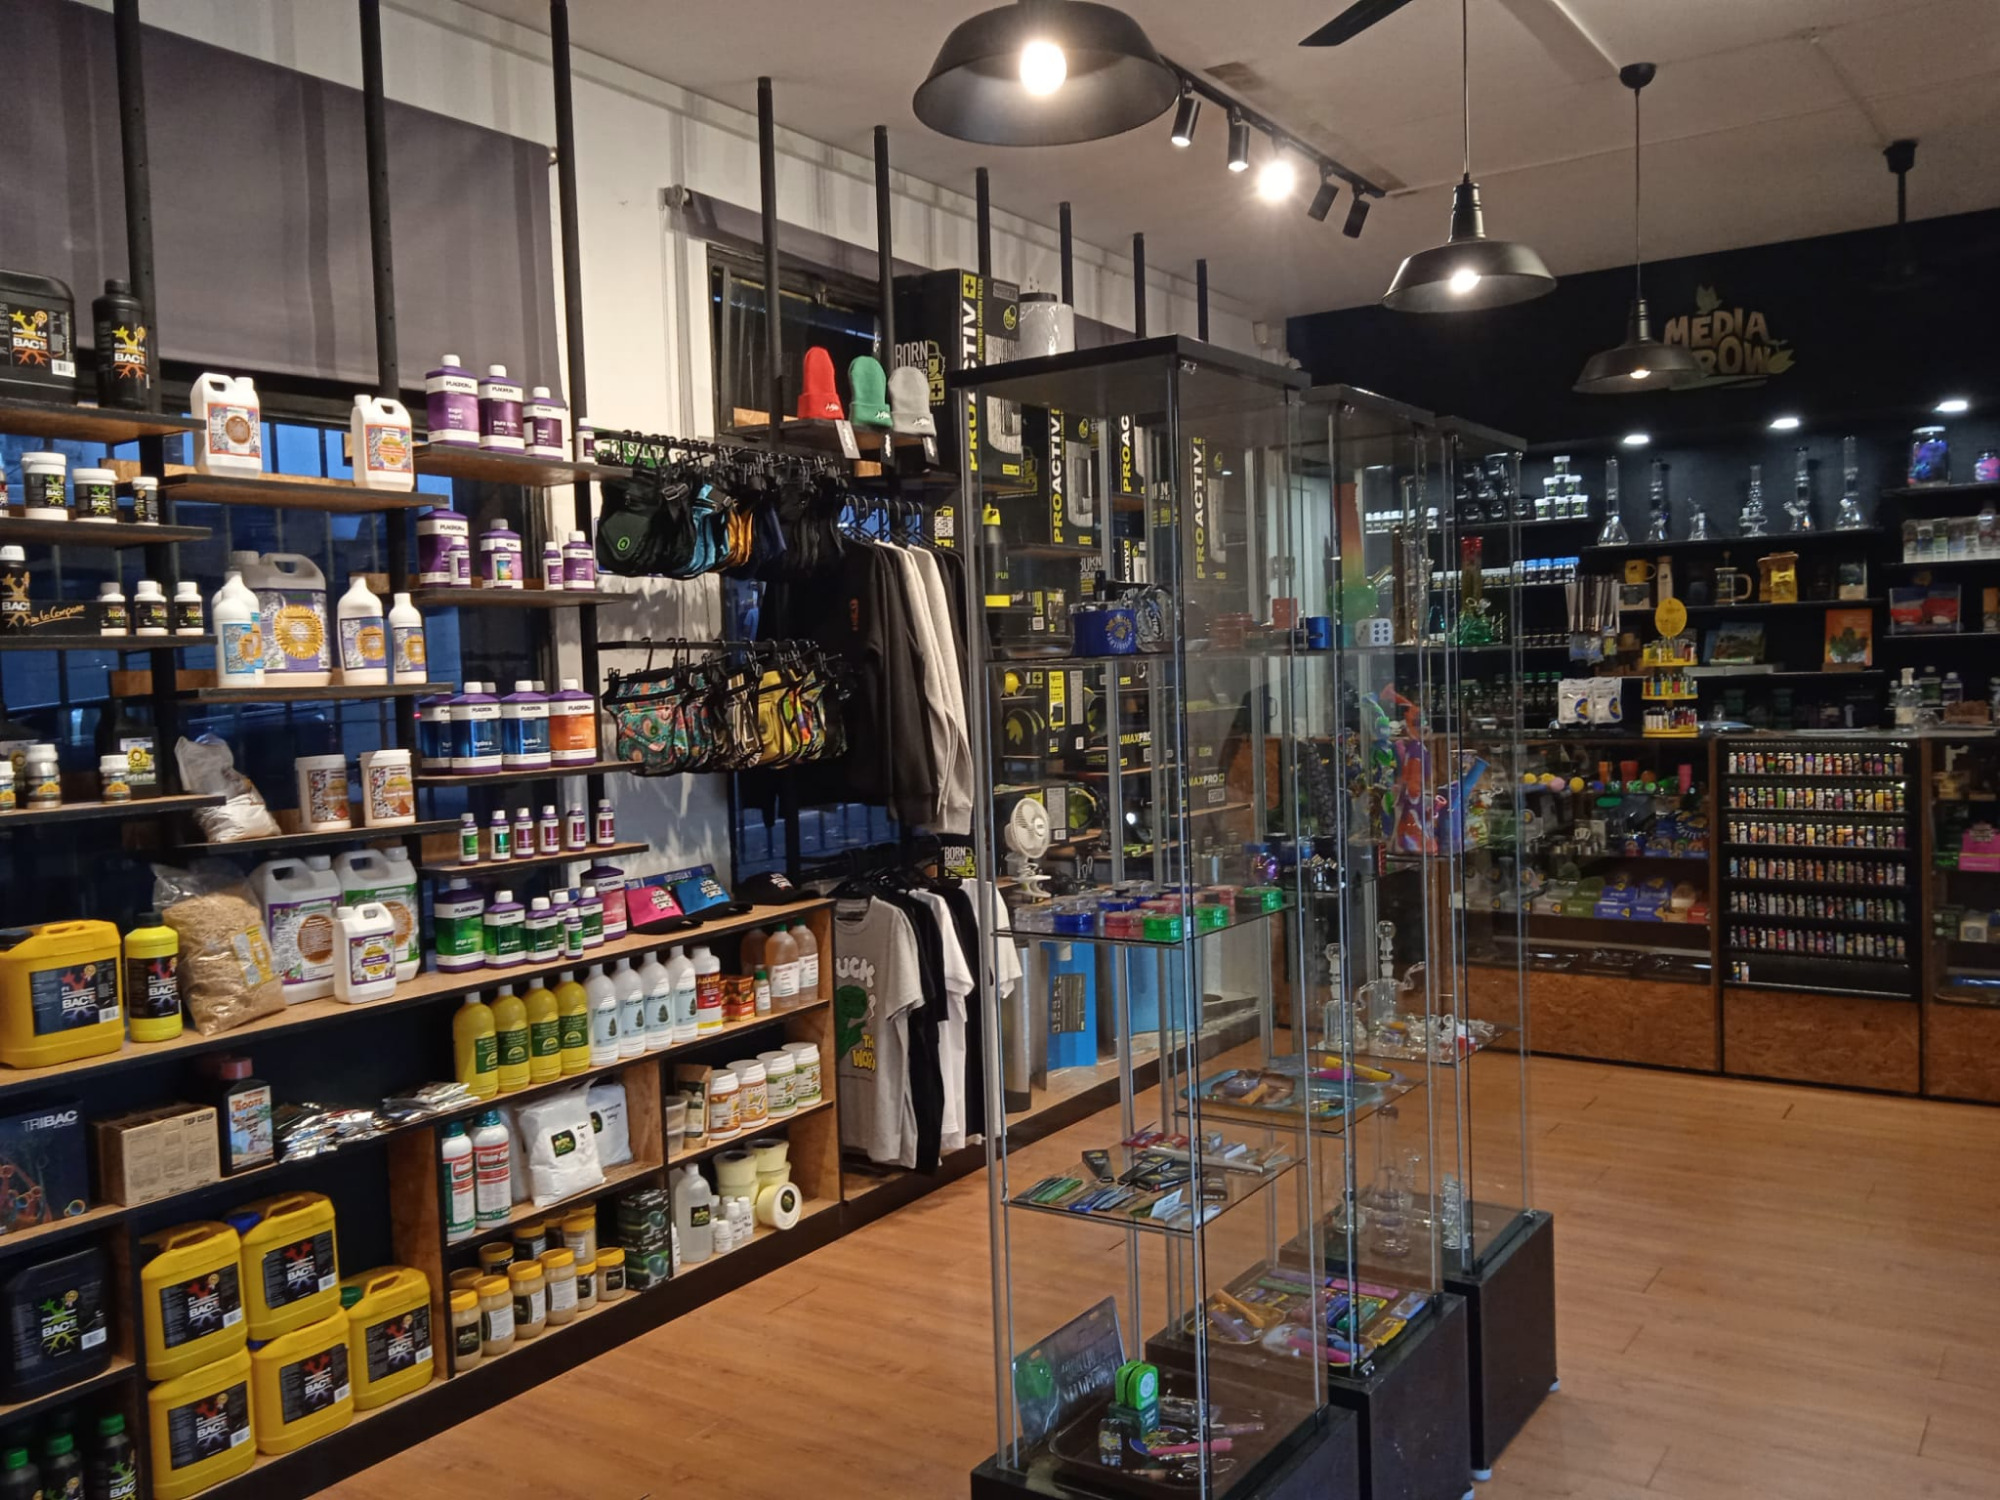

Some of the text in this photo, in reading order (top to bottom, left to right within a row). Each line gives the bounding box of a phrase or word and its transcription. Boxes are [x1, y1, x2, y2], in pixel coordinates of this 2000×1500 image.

[1664, 307, 1770, 348] MEDIA
[1690, 336, 1771, 375] ROW
[1121, 415, 1131, 493] PROAC
[835, 956, 876, 988] UCK
[21, 1110, 78, 1133] TRIBAC
